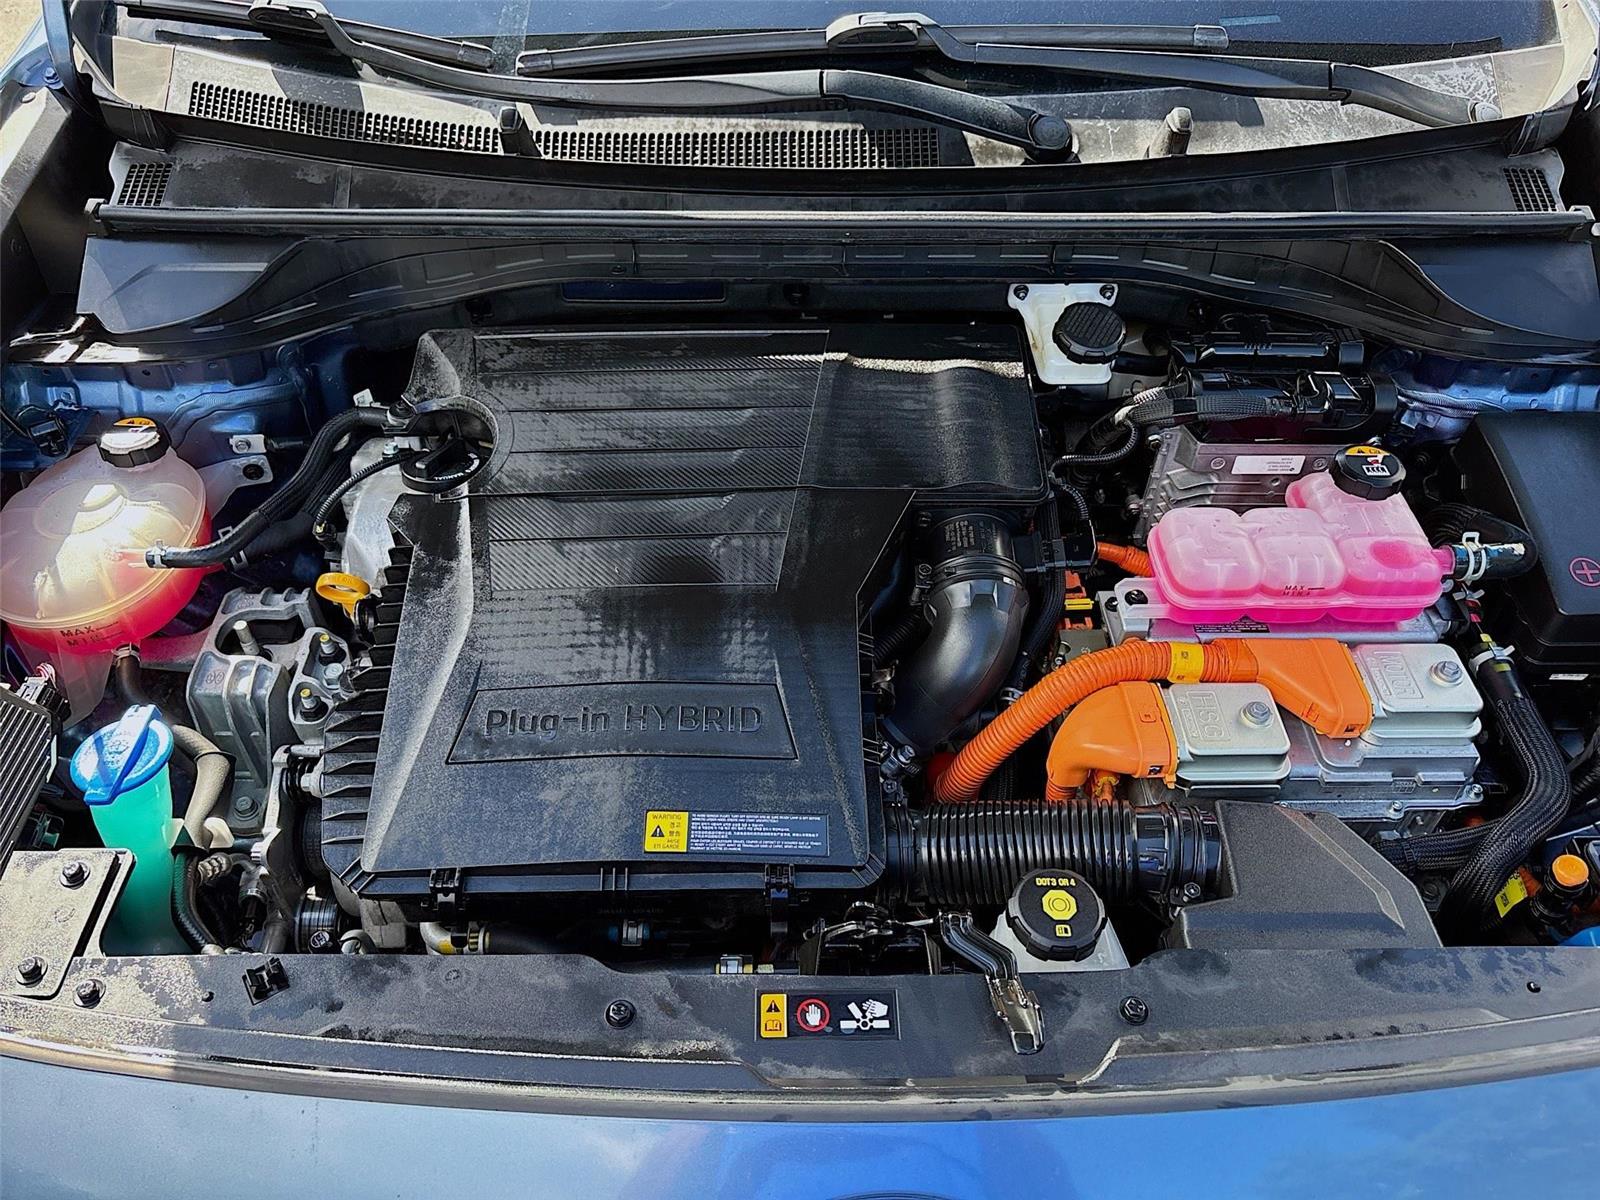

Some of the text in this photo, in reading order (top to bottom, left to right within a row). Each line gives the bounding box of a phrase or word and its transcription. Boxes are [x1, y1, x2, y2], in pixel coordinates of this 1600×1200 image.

[60, 625, 95, 637] MAX
[484, 704, 763, 741] Plug-in HYBRID
[1035, 877, 1076, 886] DOT3 OR 4
